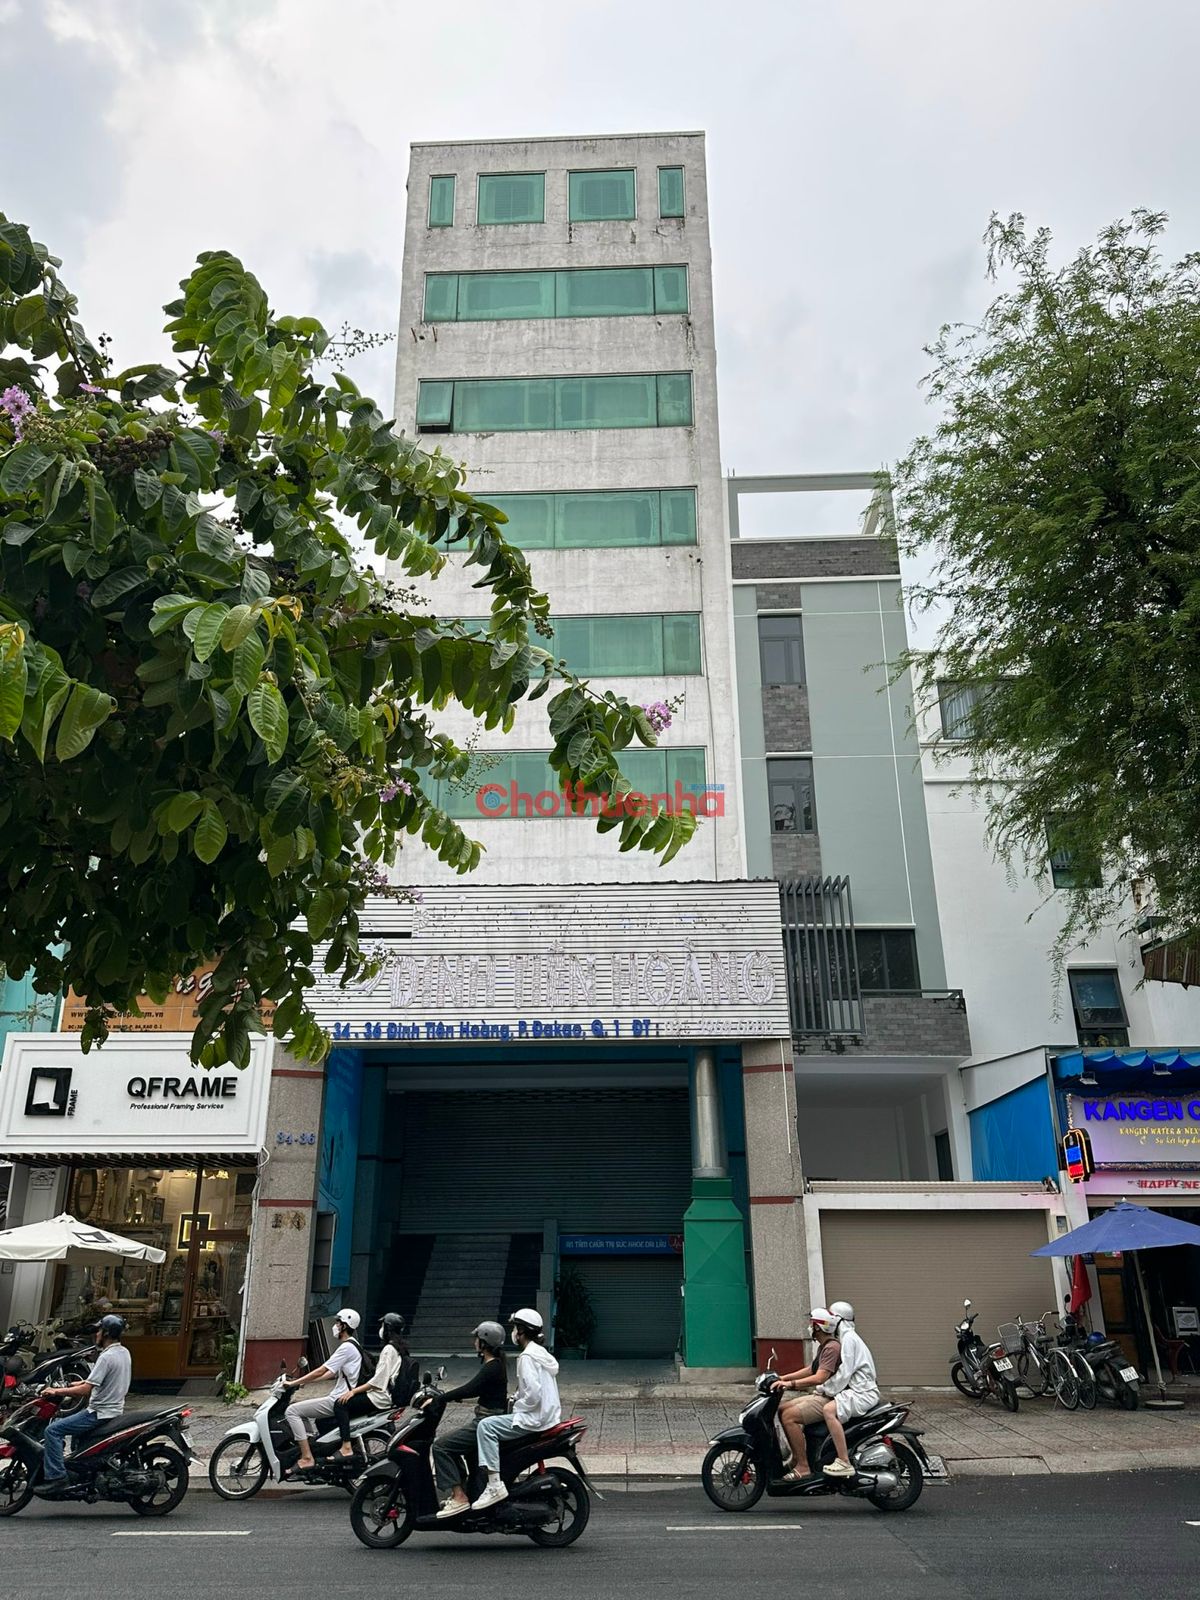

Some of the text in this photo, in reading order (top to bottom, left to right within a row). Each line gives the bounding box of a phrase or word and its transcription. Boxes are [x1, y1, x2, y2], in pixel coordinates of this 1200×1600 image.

[127, 1077, 238, 1098] QFRAME
[67, 1089, 79, 1117] FRAME
[170, 1103, 195, 1111] Framing
[1083, 1100, 1185, 1121] KANGEN
[1119, 1126, 1148, 1136] KANGEN
[1138, 1179, 1180, 1189] HAPPY
